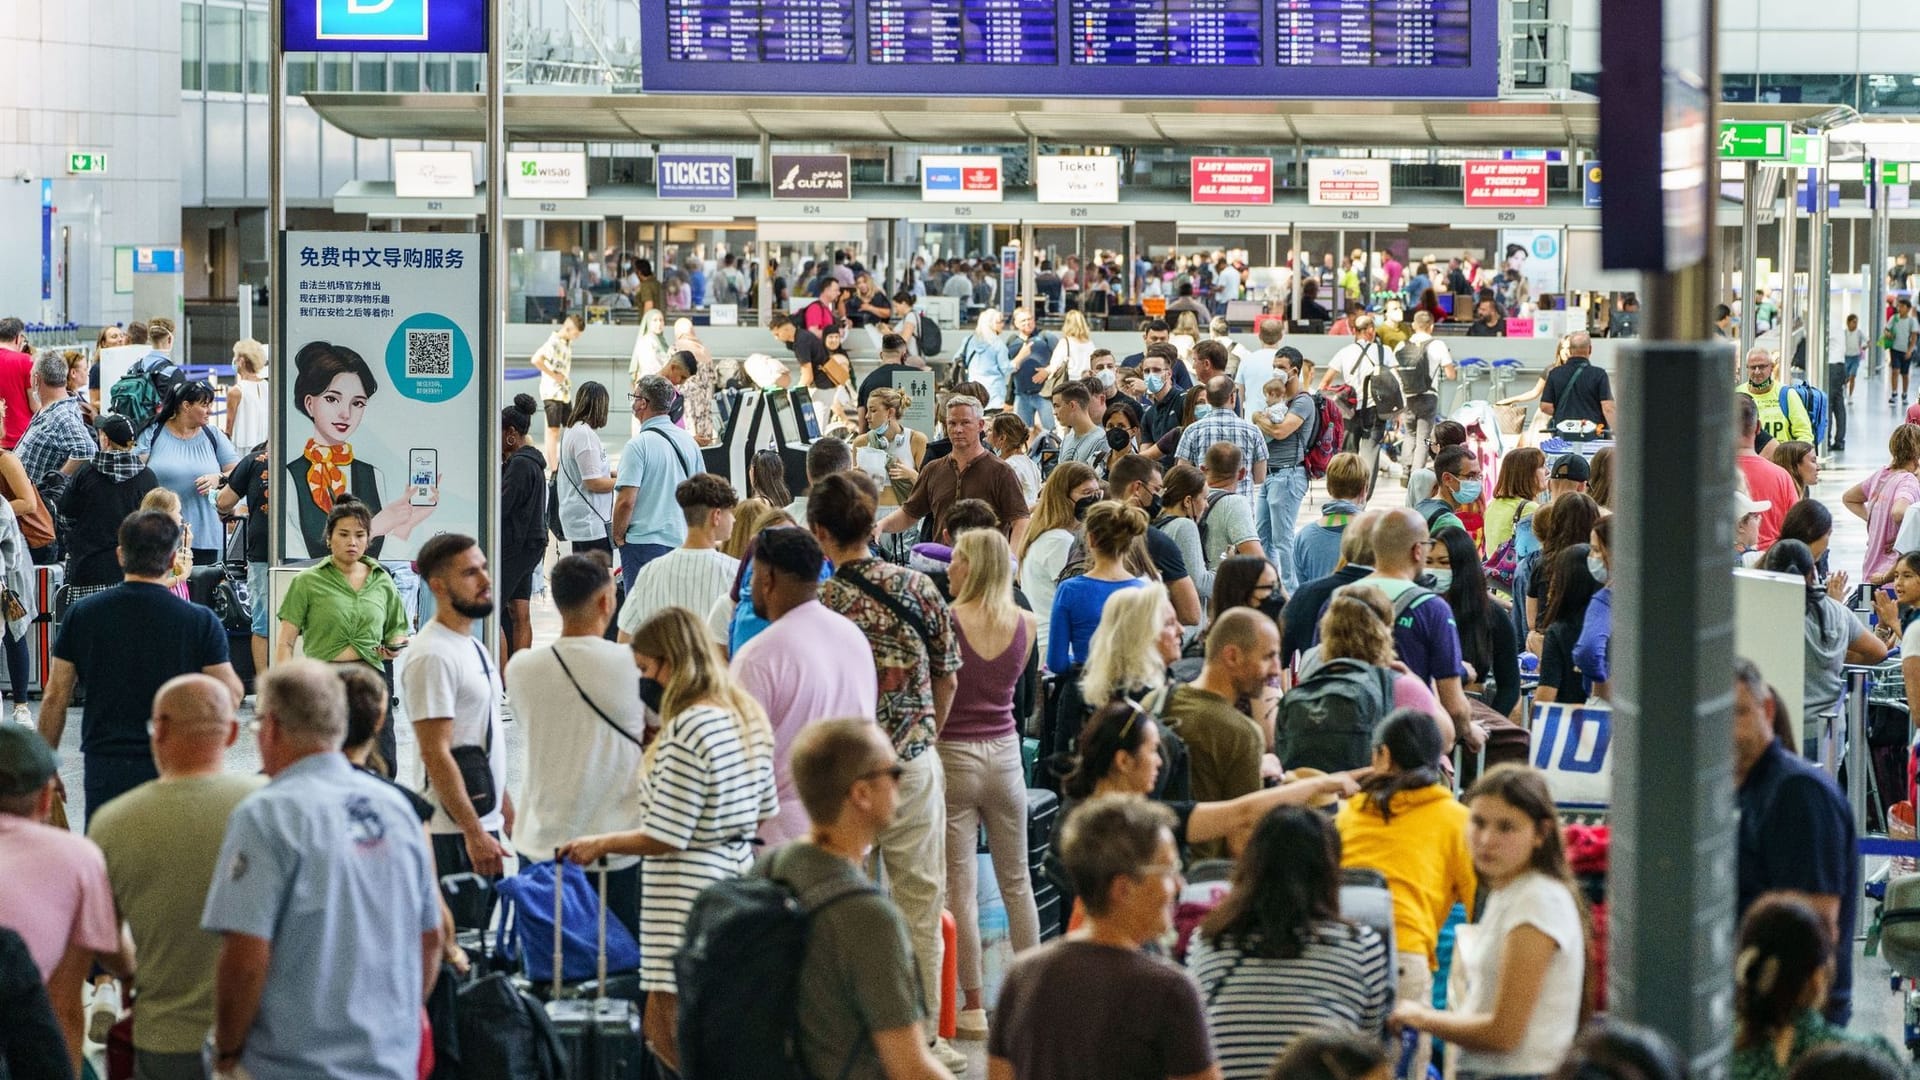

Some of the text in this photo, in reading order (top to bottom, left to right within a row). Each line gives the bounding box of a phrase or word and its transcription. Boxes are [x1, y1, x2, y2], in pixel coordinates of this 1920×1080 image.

[1058, 160, 1096, 172] Ticket
[1198, 162, 1266, 172] LAST MINUTE
[1470, 165, 1540, 175] LAST MINUTE
[661, 161, 731, 185] TICKETS
[1211, 174, 1253, 183] TICKETS
[1484, 176, 1528, 186] TICKETS
[797, 179, 843, 189] GULF AIR
[1198, 185, 1266, 195] ALL AIRLINES
[1471, 187, 1540, 197] ALL AIRLINES
[299, 246, 464, 269] 免费中文导购服务
[299, 280, 381, 291] 由法兰机场官方推出
[299, 294, 390, 304] 现在预订即享购物乐趣
